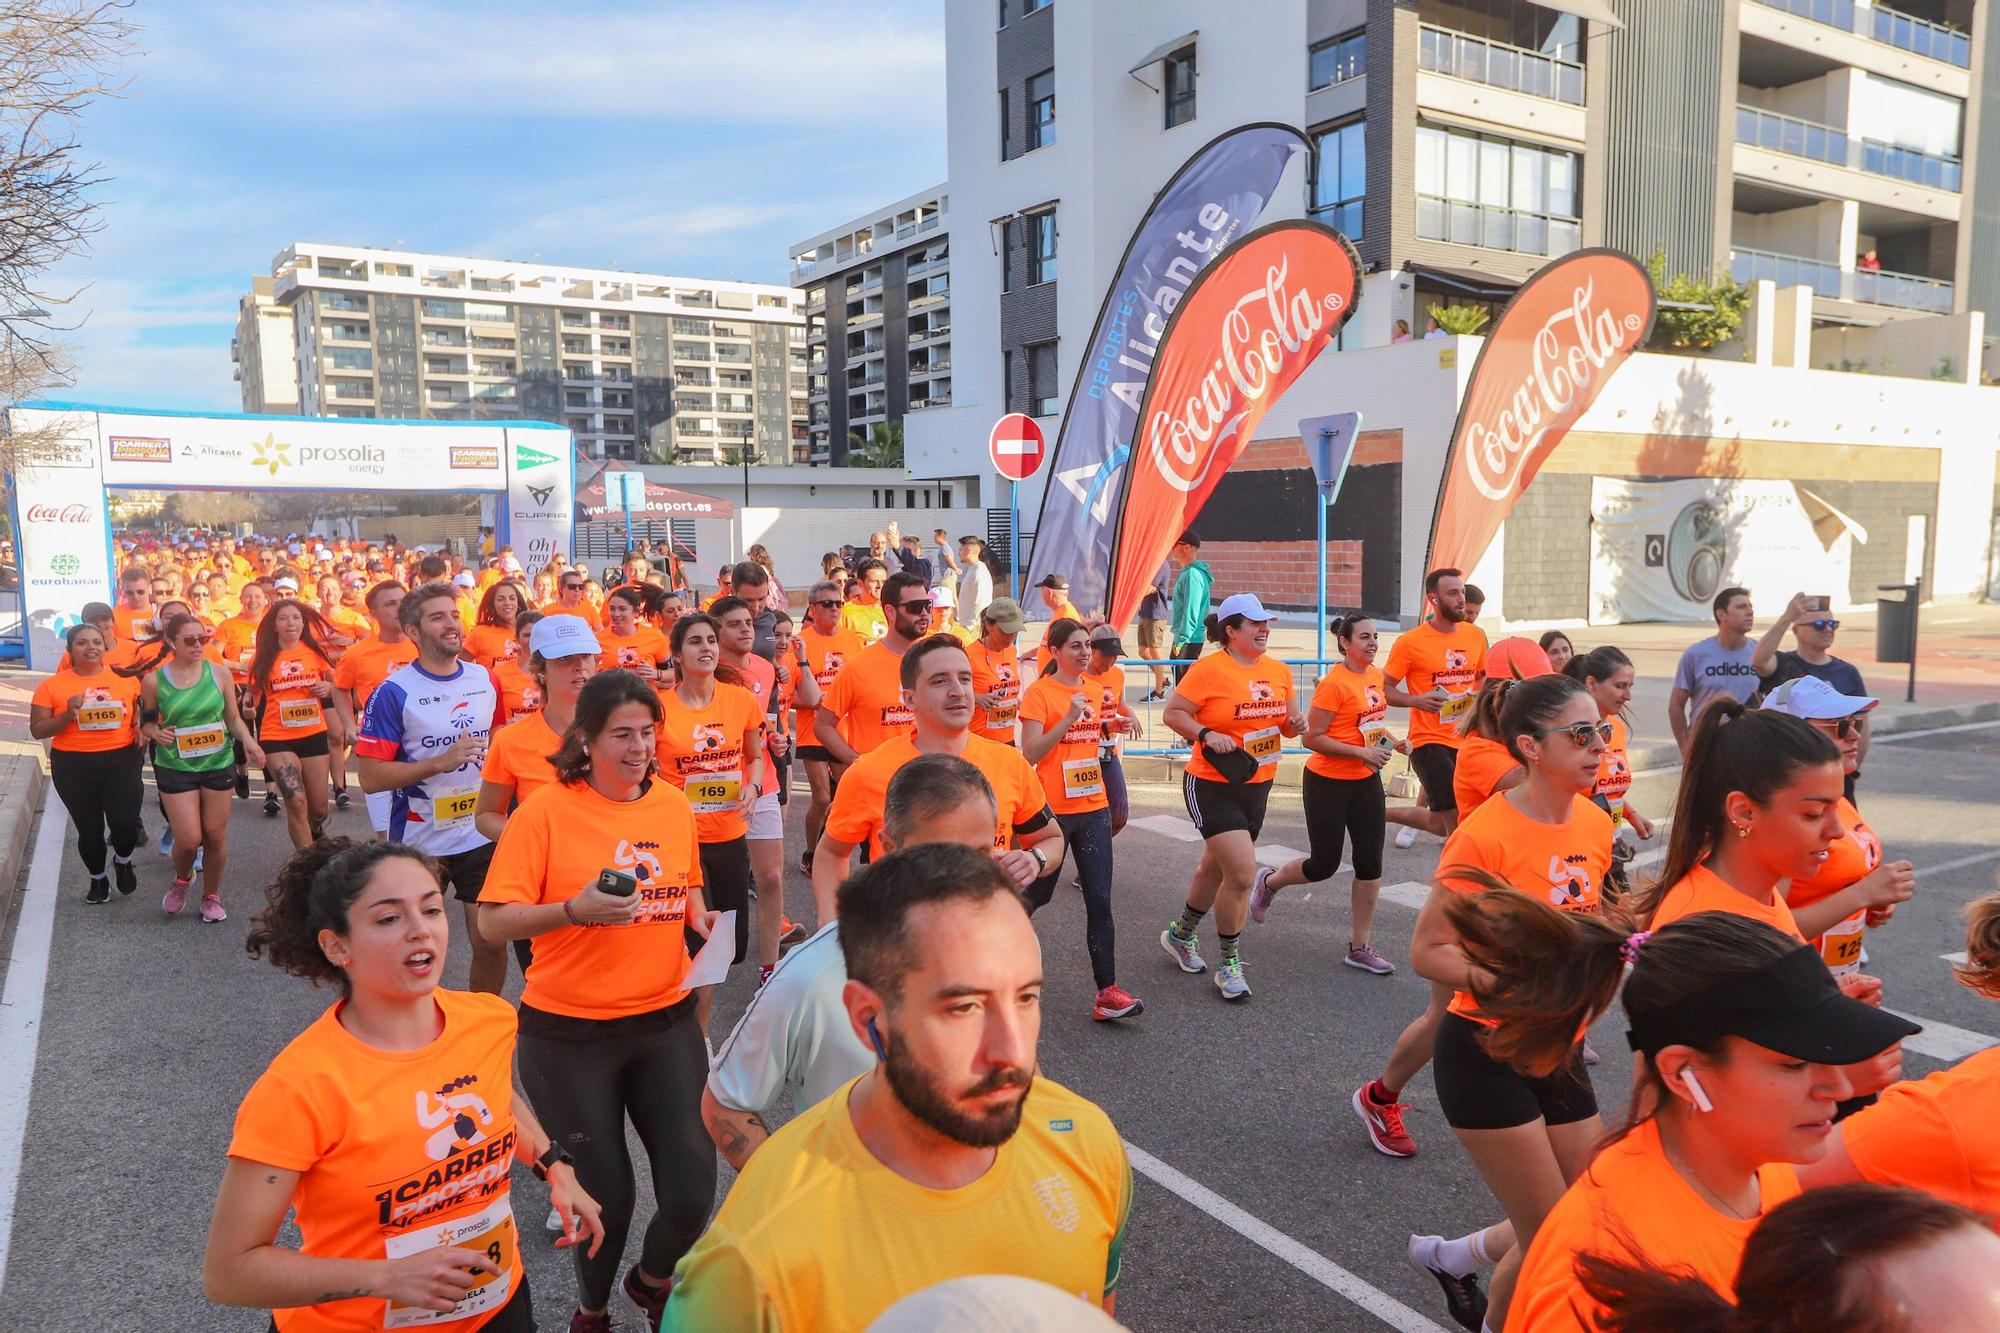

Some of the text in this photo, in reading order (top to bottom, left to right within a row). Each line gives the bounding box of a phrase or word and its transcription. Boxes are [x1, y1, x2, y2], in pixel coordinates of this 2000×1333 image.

[1215, 218, 1241, 251] Deportes
[1087, 289, 1138, 400] DEPORTES
[1152, 252, 1322, 493] Coca-Cola
[1465, 275, 1625, 501] Coca-Cola
[118, 440, 169, 449] CARRERA
[201, 446, 242, 457] Alicante
[299, 444, 385, 466] prosolia
[349, 463, 385, 475] energy
[27, 503, 93, 523] Coca-Cola
[514, 511, 567, 519] CUPRA
[529, 537, 549, 552] Oh
[529, 554, 549, 565] my
[1706, 661, 1758, 677] adidas
[273, 673, 316, 684] CARRERA
[1451, 701, 1466, 711] 147
[87, 711, 116, 720] 1165
[886, 712, 916, 721] PROS
[187, 734, 216, 747] 1239
[1252, 740, 1274, 753] 1247
[681, 747, 742, 764] CARRERA
[1074, 770, 1098, 783] 1035
[699, 786, 726, 797] 169
[450, 798, 476, 813] 167
[641, 885, 687, 901] RERA
[395, 1131, 513, 1203] CARRER
[457, 1217, 491, 1238] prosolia
